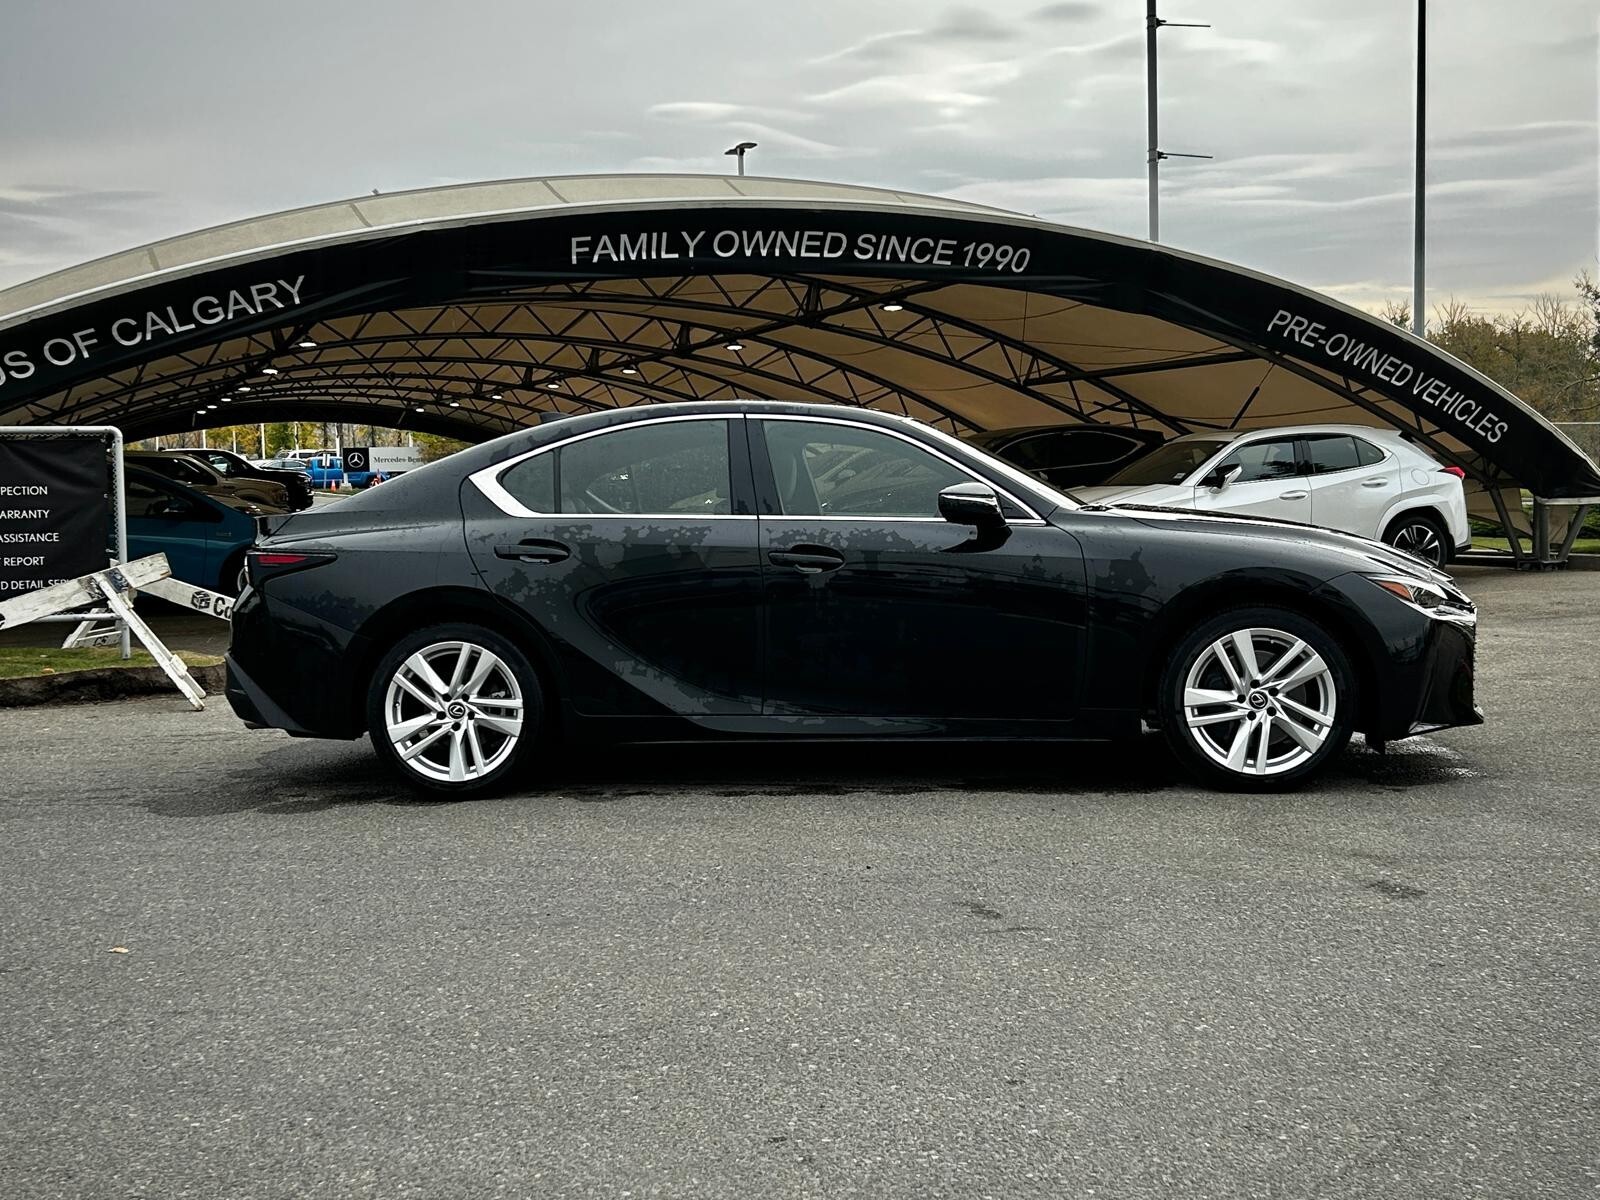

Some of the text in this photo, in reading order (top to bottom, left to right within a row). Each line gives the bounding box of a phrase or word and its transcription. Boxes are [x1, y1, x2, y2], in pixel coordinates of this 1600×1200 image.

[572, 230, 1031, 273] FAMILY OWNED SINCE 1990
[0, 275, 305, 386] S OF CALGARY
[1266, 309, 1508, 443] PRE-OWNED VEHICLES
[0, 485, 48, 496] PECTION
[0, 509, 50, 519] ARRANTY
[3, 556, 45, 567] REPORT
[10, 579, 45, 590] DETAIL
